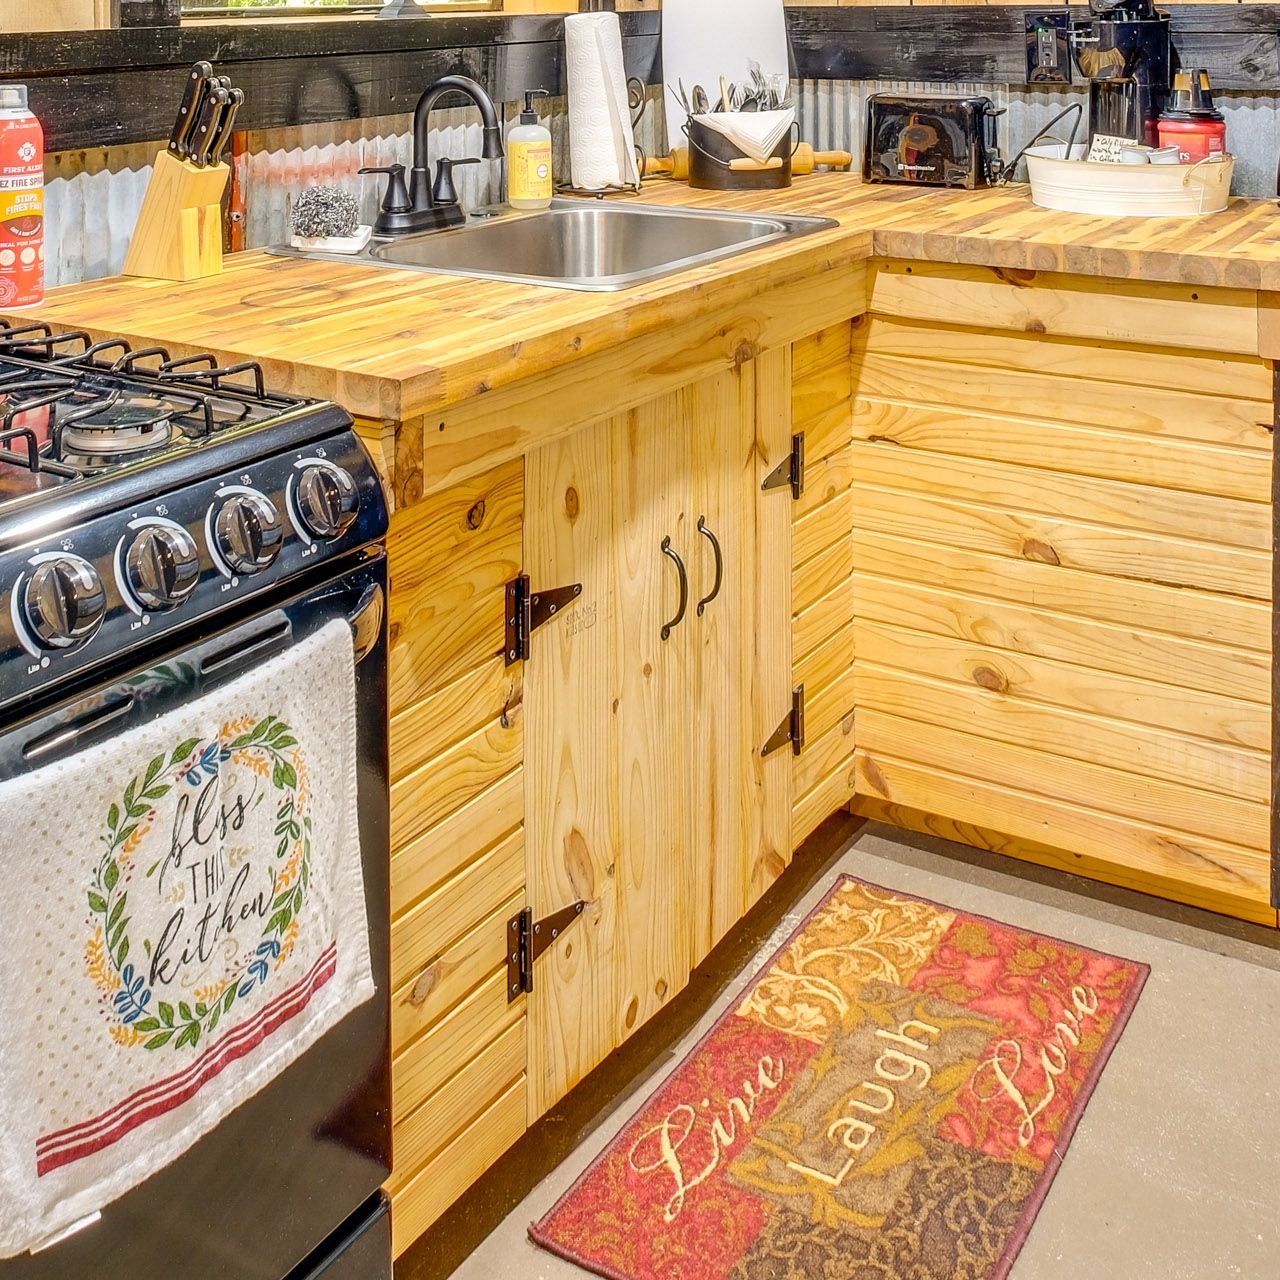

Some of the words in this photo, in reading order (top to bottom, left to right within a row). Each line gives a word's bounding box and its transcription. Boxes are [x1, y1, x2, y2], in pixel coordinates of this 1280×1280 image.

[0, 180, 9, 188] EZ
[11, 178, 28, 188] FIRE
[3, 166, 26, 174] FIRST
[158, 774, 258, 896] bless
[185, 845, 226, 905] THIS
[786, 1017, 948, 1188] Laugh
[969, 980, 1102, 1148] Love
[628, 1050, 786, 1224] Live
